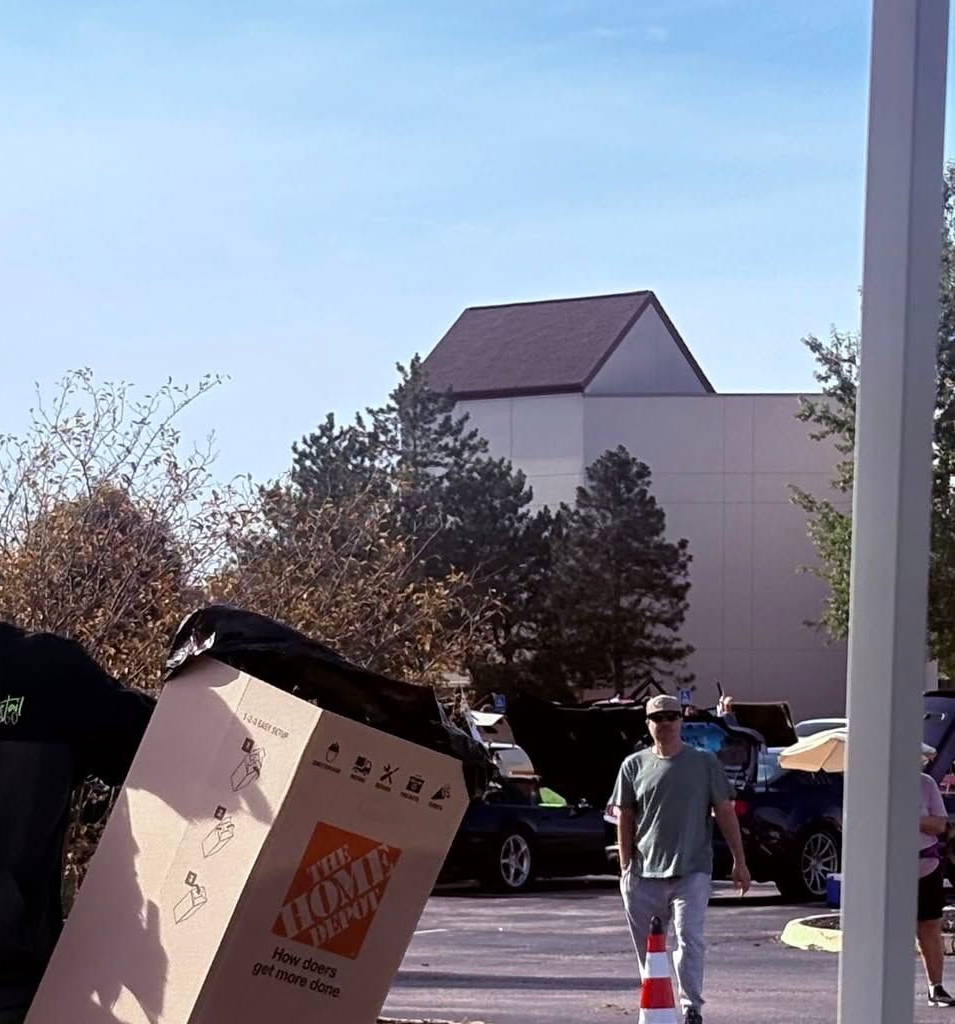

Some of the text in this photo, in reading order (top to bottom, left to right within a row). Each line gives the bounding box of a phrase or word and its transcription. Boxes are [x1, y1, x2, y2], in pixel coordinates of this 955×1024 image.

[305, 844, 352, 883] THE
[282, 841, 394, 939] HOME
[310, 888, 380, 947] DEPOT
[252, 962, 275, 976] get
[275, 969, 307, 987] more
[272, 946, 338, 978] How doers
